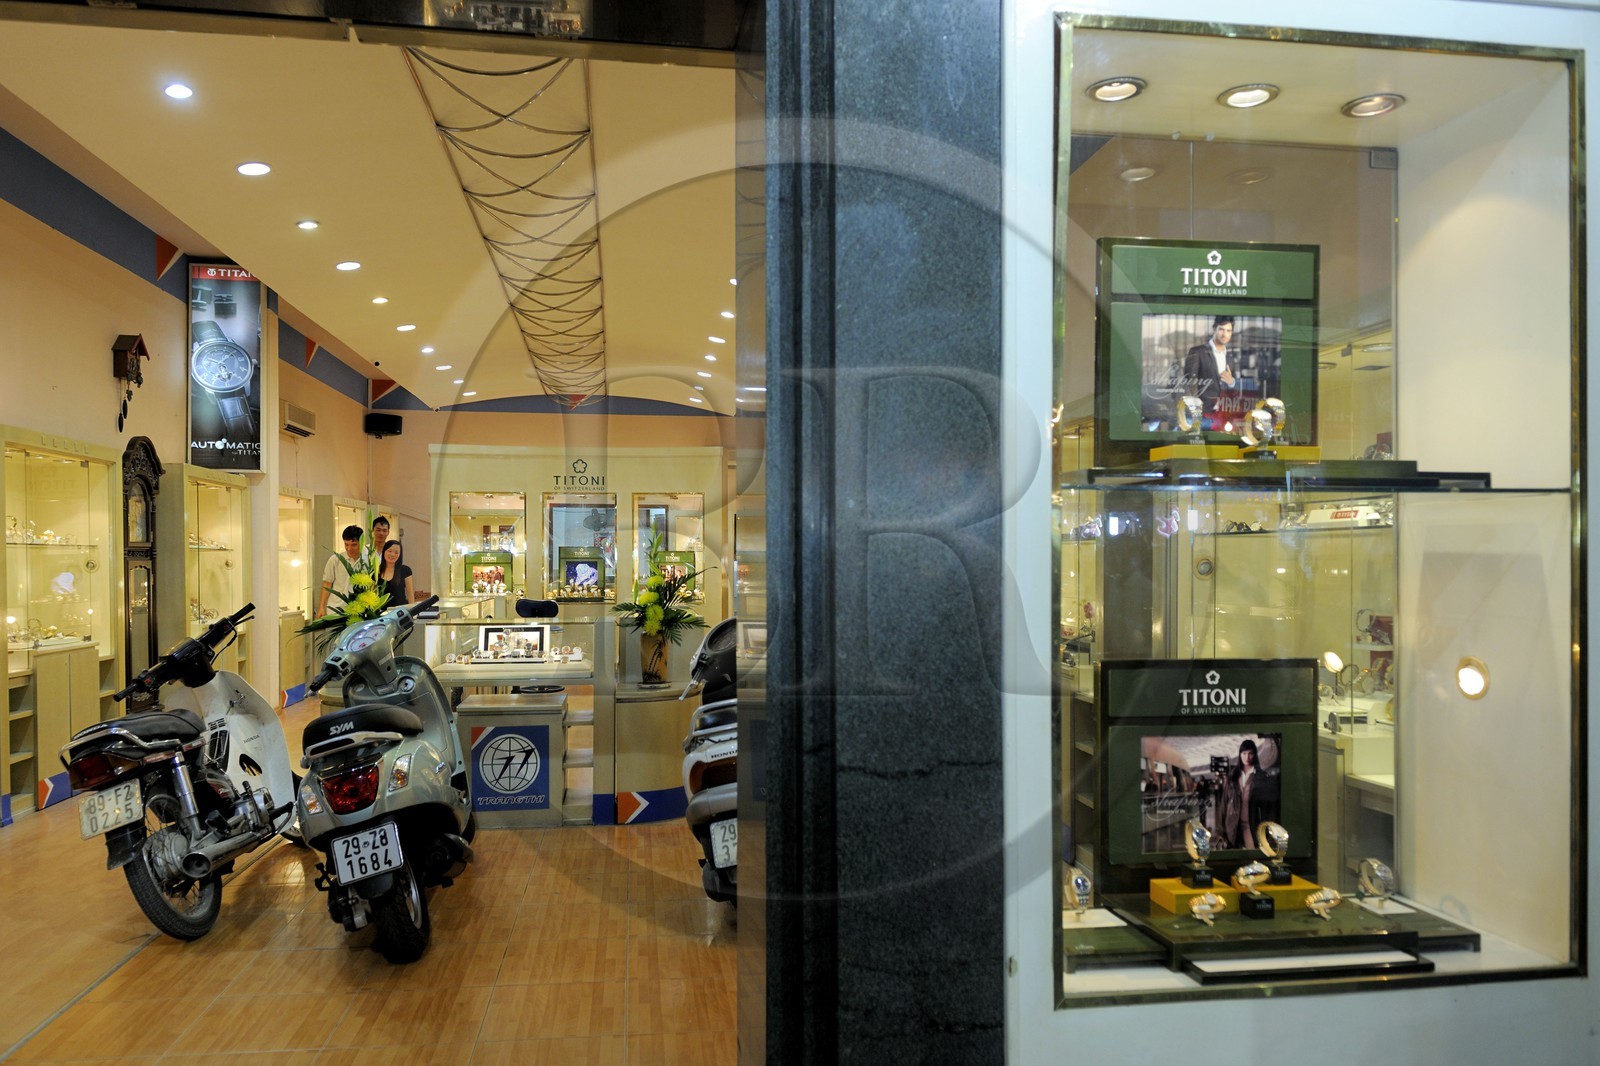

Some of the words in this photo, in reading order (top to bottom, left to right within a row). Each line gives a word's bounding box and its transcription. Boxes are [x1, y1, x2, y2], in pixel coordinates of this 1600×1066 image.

[1180, 267, 1248, 287] TITONI
[1194, 287, 1248, 296] SWITZERLAND
[553, 475, 605, 486] TITONI
[1178, 688, 1247, 706] TITONI
[1193, 706, 1247, 714] SWITZERLAND
[329, 720, 355, 736] SYM
[347, 848, 393, 879] 1684
